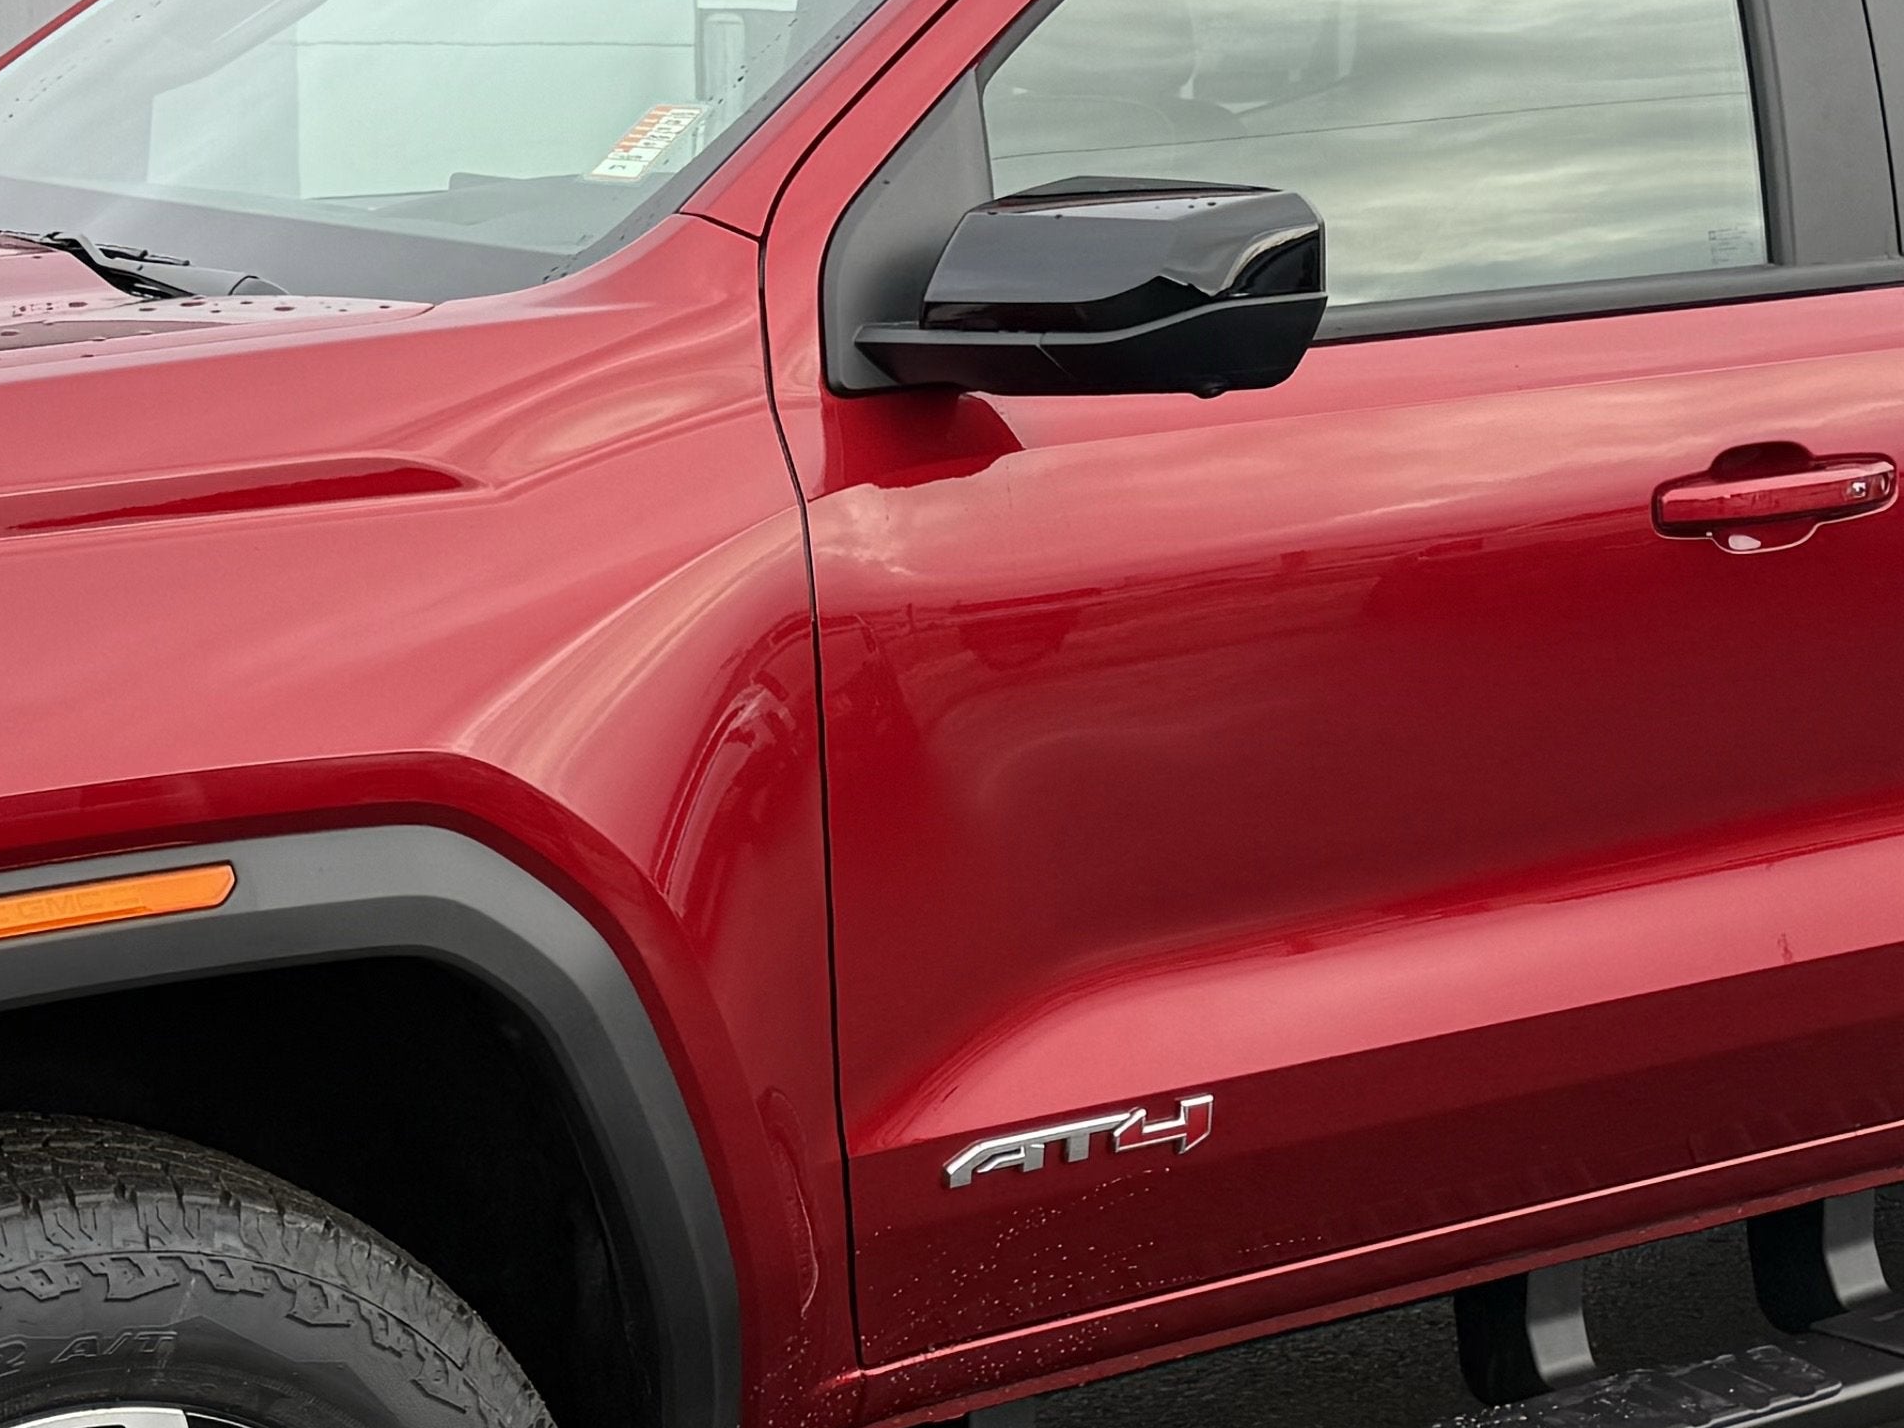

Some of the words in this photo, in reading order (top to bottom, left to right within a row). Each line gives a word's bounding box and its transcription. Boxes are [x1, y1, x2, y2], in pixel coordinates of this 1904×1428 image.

[17, 890, 105, 919] GMC
[942, 1093, 1214, 1189] AT4
[49, 1329, 178, 1365] A/T
